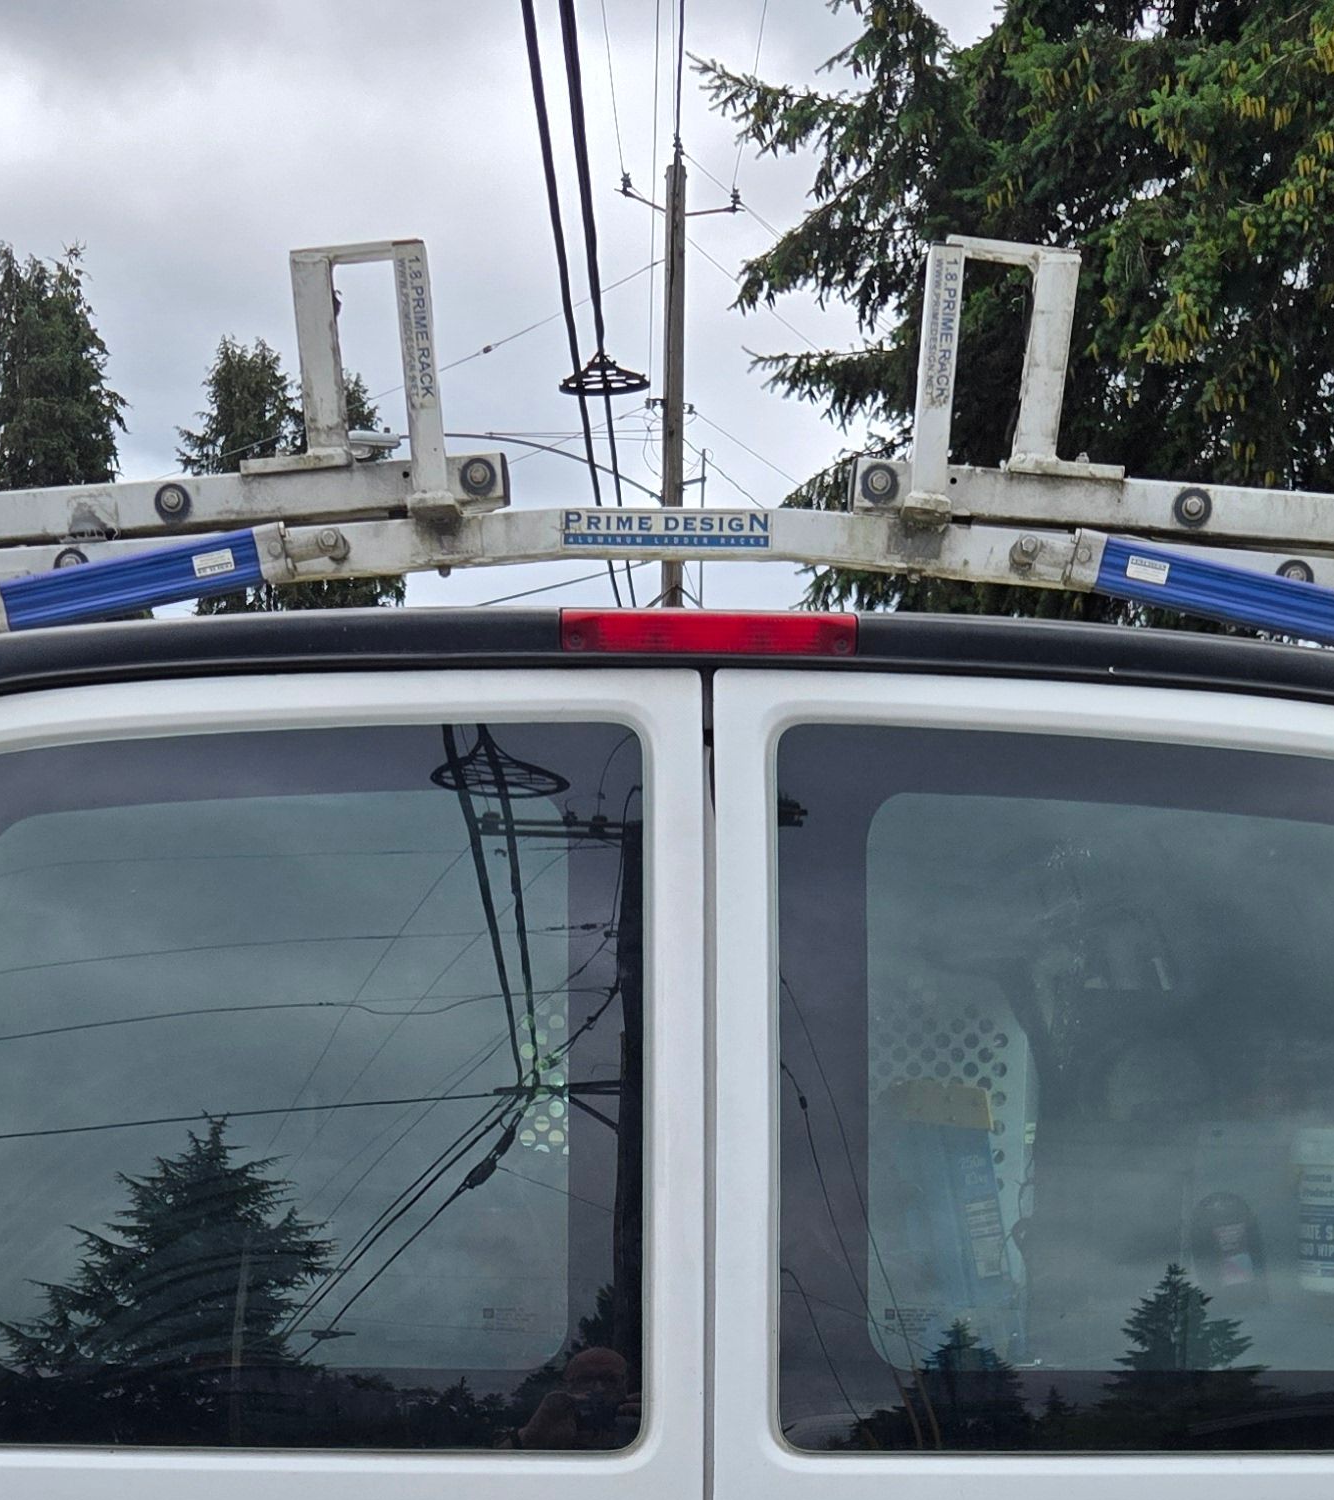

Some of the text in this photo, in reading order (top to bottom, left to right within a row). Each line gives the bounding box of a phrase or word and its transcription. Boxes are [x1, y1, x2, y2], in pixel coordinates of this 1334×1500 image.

[564, 511, 769, 533] PRIME DESIGN
[653, 536, 708, 545] LADDER
[720, 537, 765, 546] RACKS
